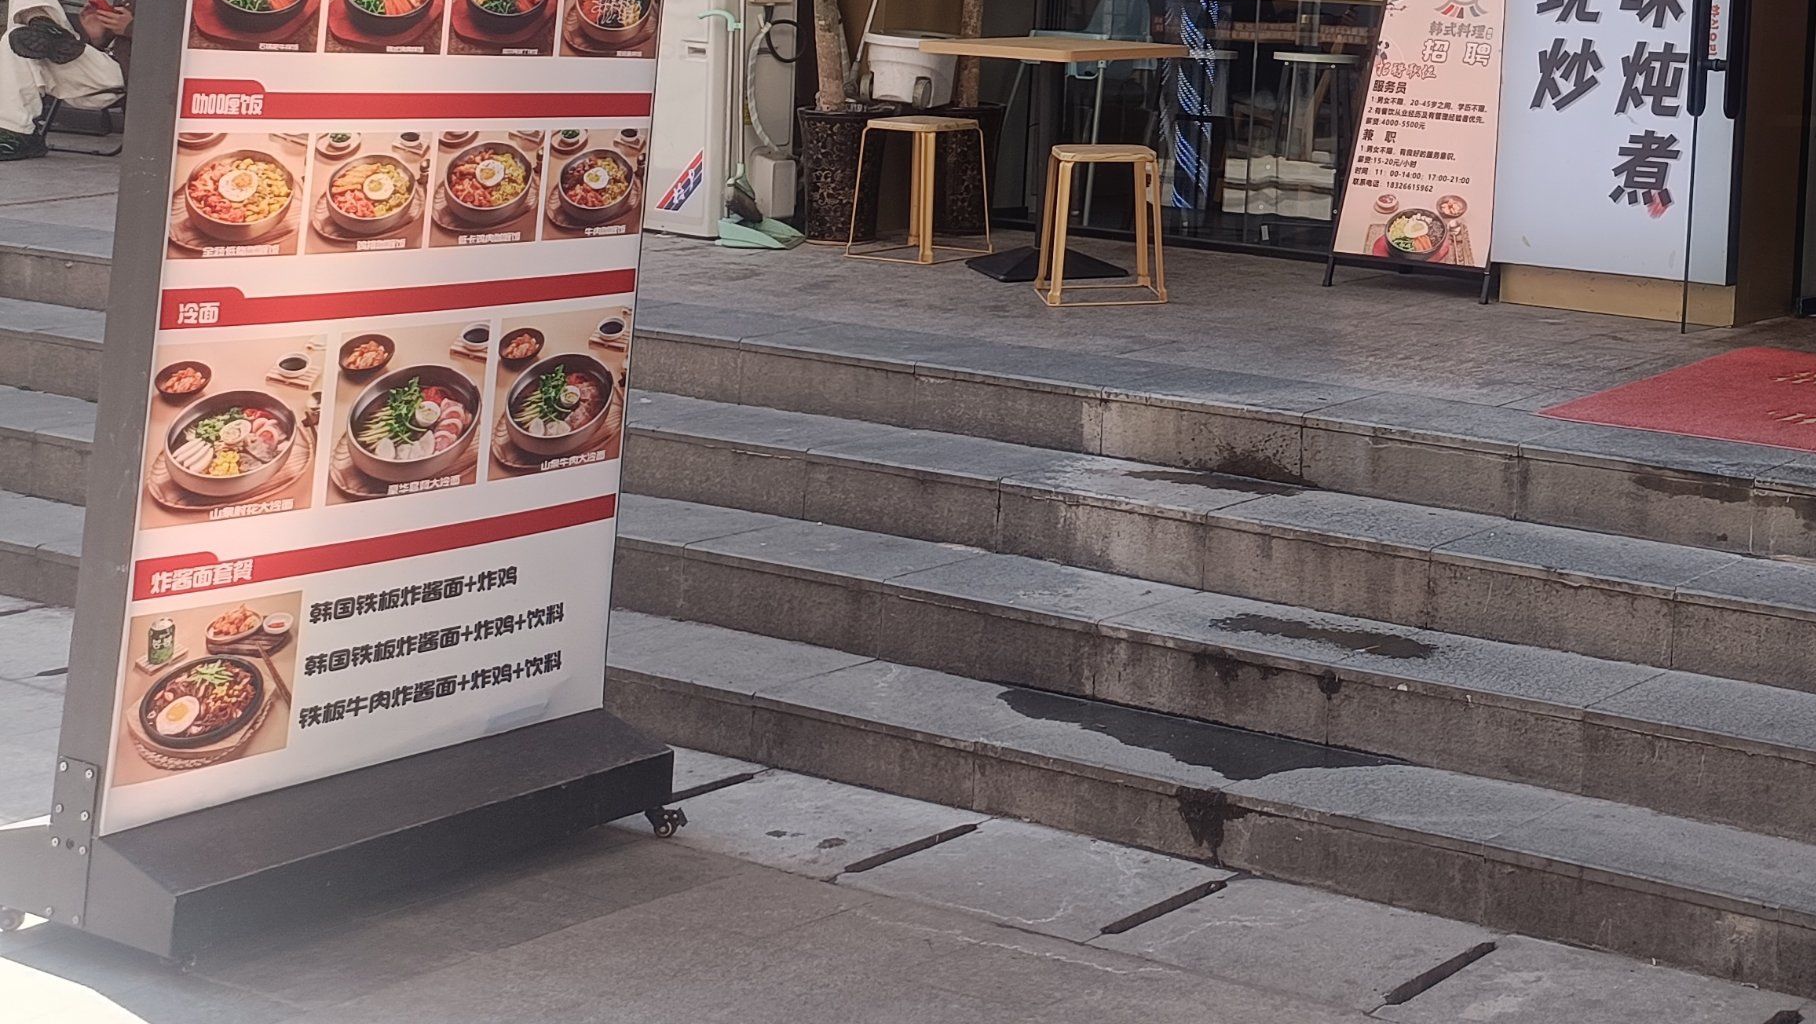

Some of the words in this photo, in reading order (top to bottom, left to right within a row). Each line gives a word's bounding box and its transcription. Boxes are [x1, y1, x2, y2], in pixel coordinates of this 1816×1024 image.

[1429, 21, 1486, 39] 韩式料理
[1422, 39, 1450, 64] 招
[1463, 42, 1491, 67] 聘
[1373, 80, 1407, 94] 服务员
[191, 93, 263, 115] 咖喱饭
[1362, 129, 1375, 142] 兼
[1384, 131, 1397, 144] 职
[178, 301, 220, 325] 冷面
[150, 558, 254, 594] 炸酱面套餐
[309, 565, 518, 624] 韩国铁板炸酱面+炸鸡
[304, 602, 564, 677] 韩国铁板炸酱面+炸鸡+饮料
[299, 650, 562, 729] 铁板牛肉炸酱面+炸鸡+饮料
